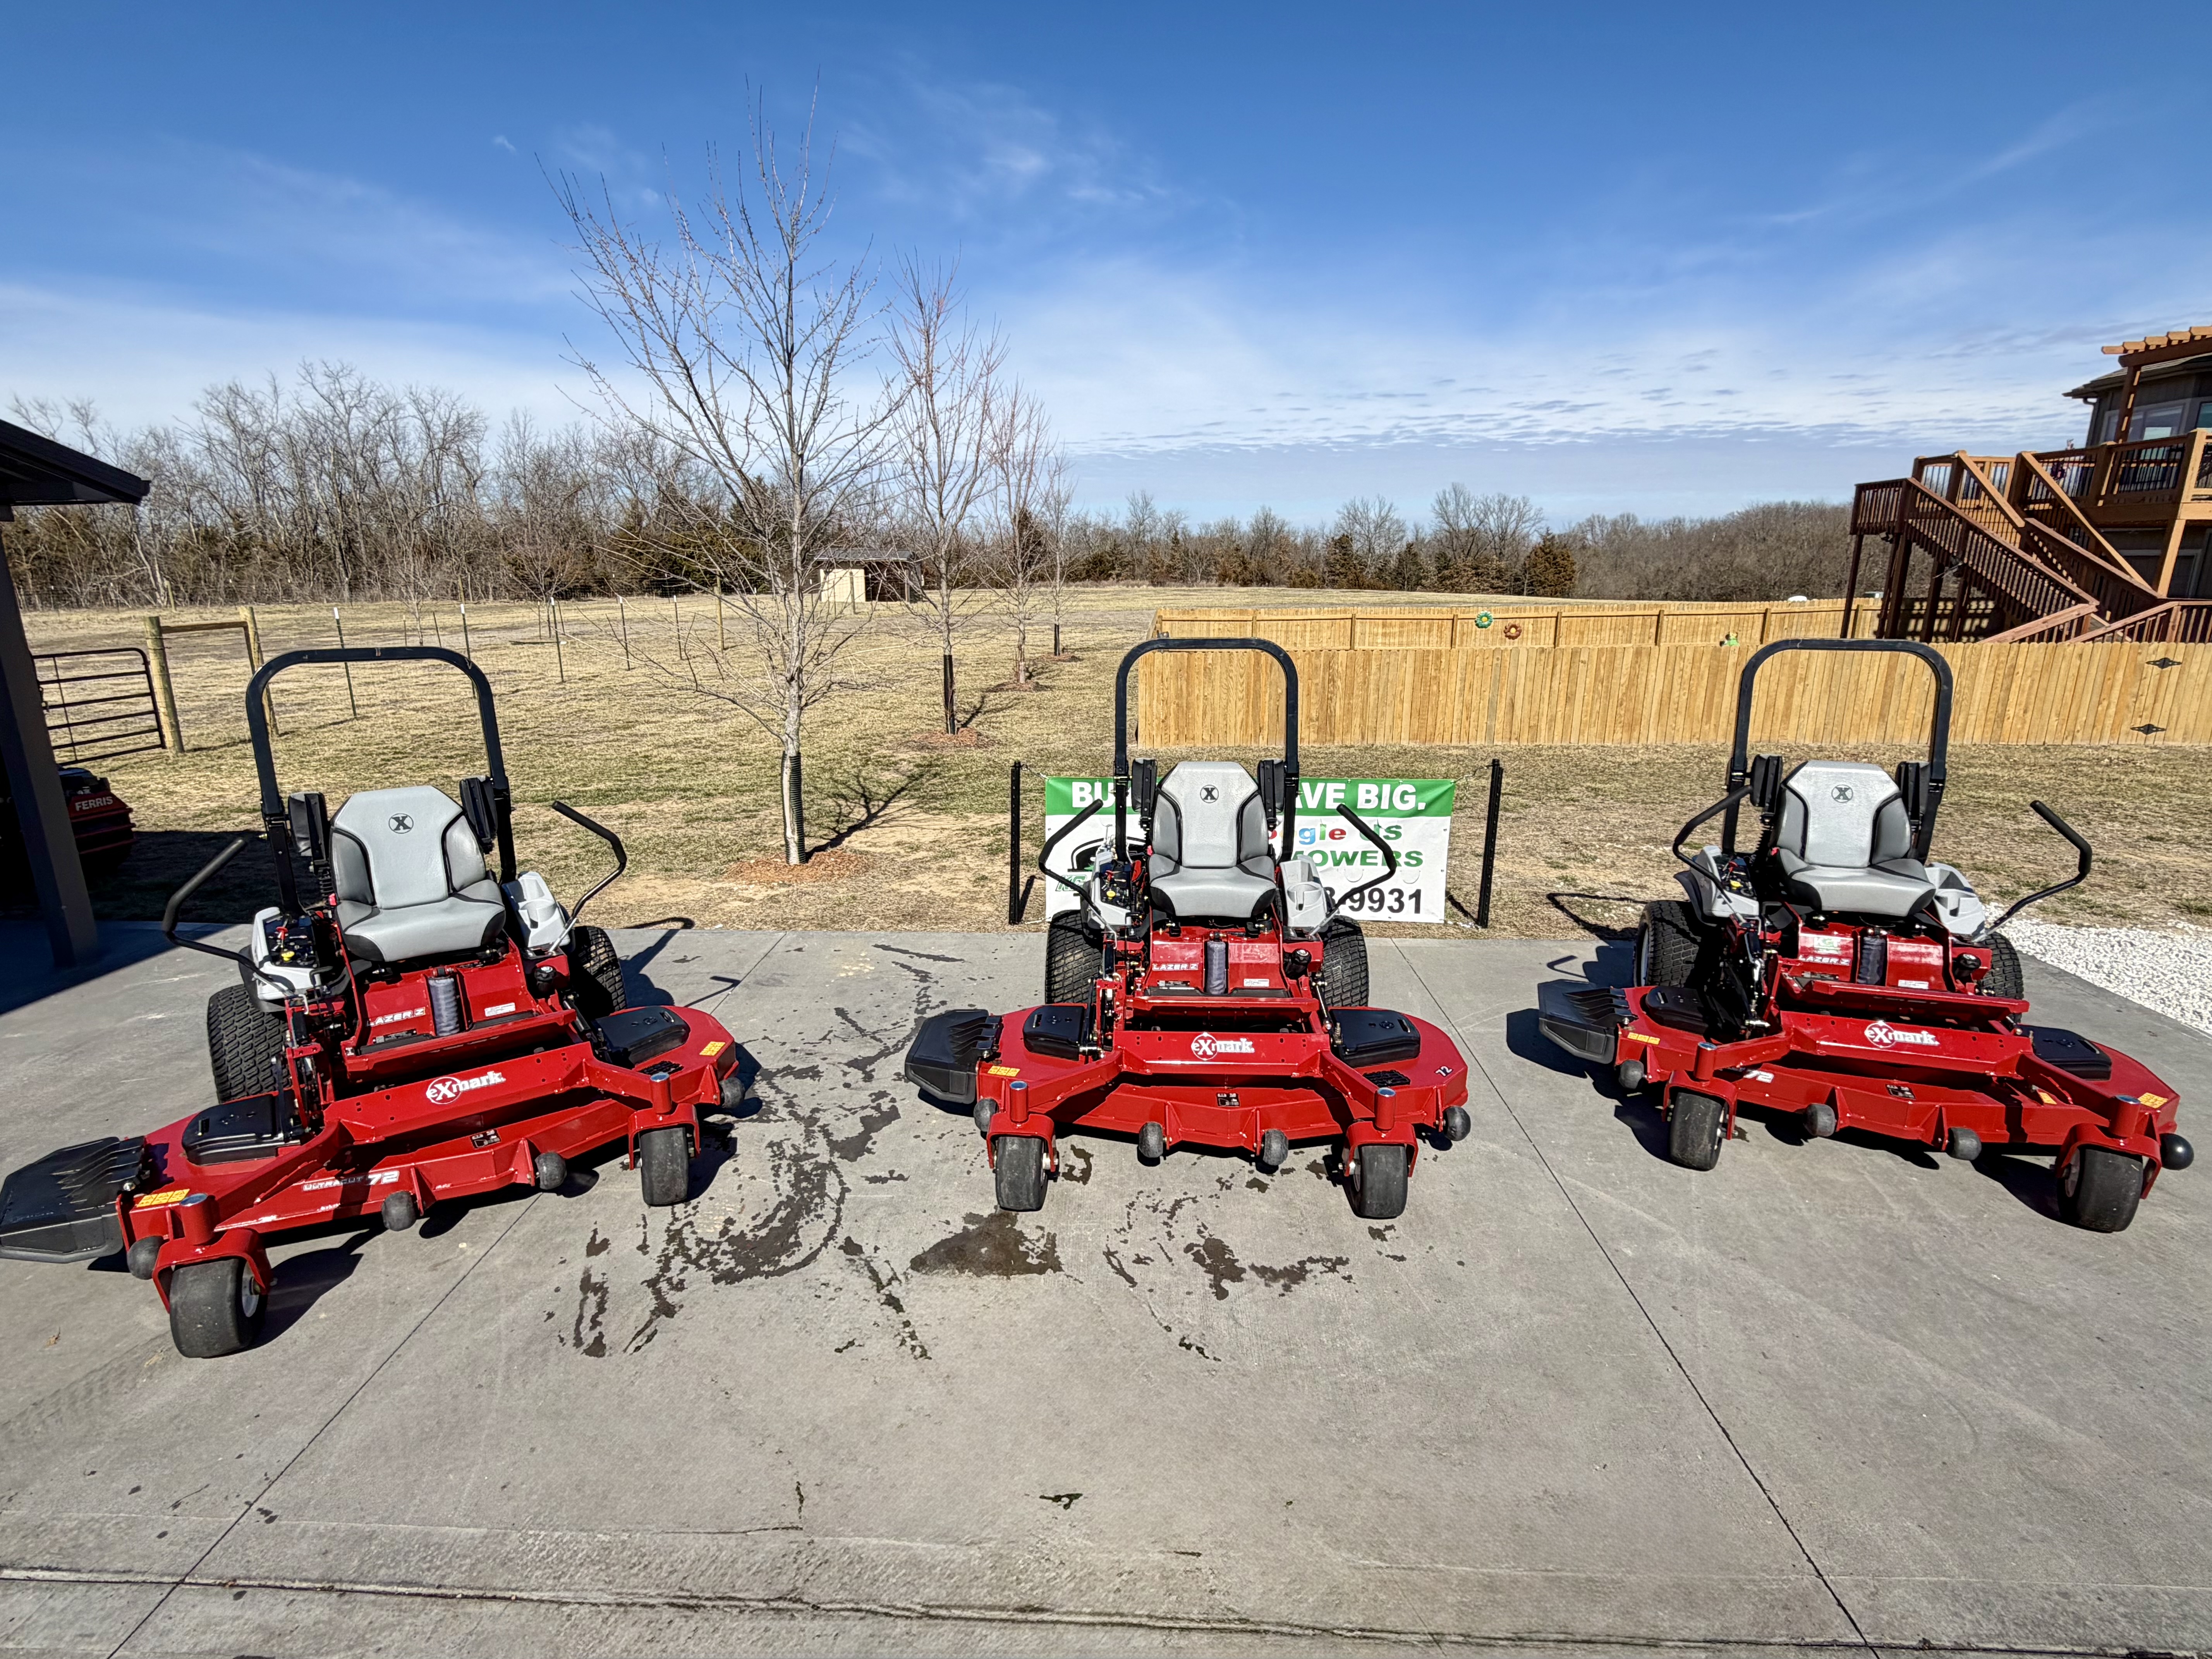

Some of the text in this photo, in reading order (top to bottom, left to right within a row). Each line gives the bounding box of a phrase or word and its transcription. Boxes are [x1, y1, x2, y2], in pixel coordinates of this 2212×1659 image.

[75, 796, 113, 811] FERRIS
[1072, 781, 1426, 810] BU VE BIG.
[1269, 824, 1346, 845] gle
[1798, 955, 1839, 964] LAZER
[367, 1008, 425, 1026] LAZER Z
[368, 1171, 400, 1185] 72
